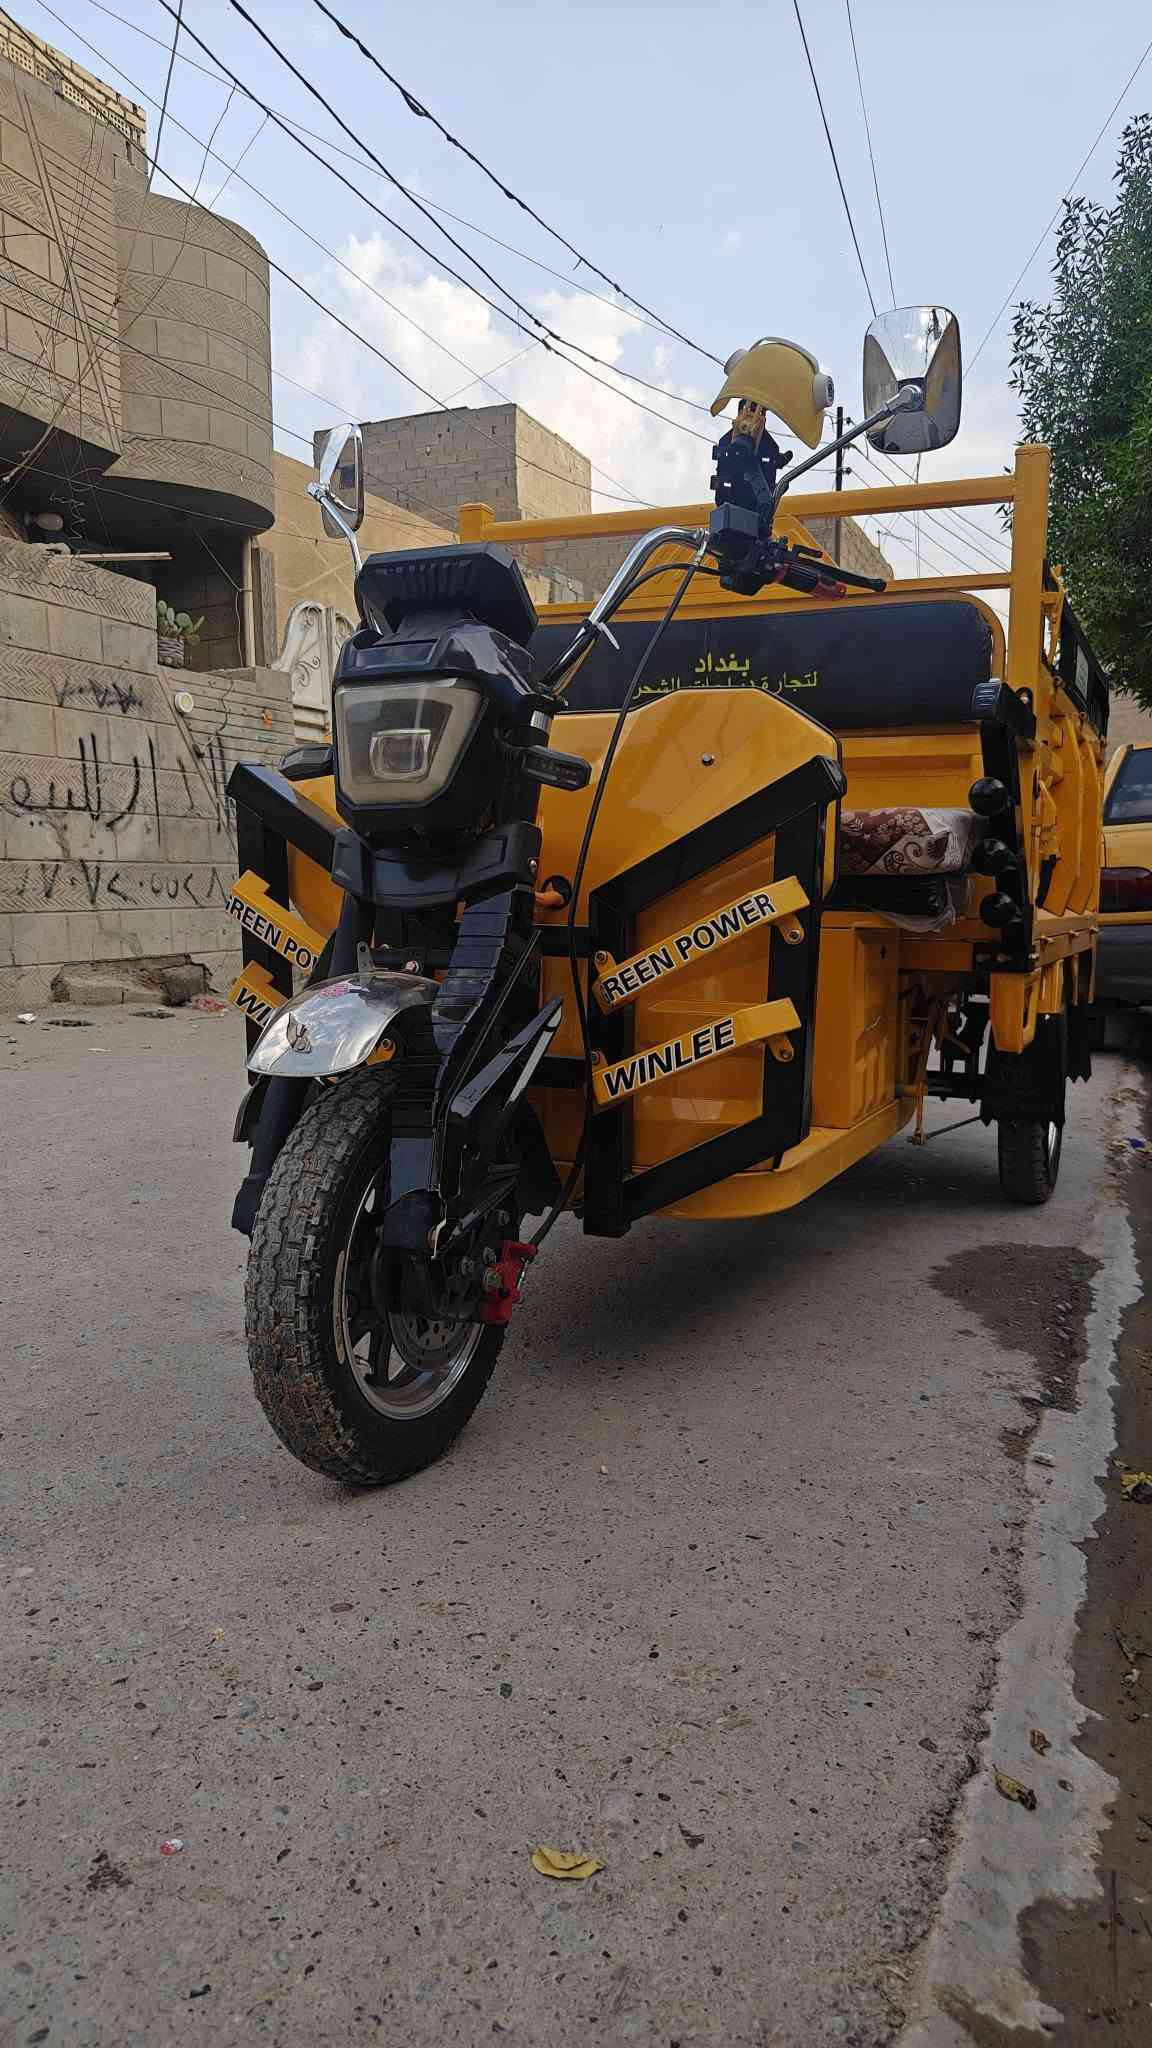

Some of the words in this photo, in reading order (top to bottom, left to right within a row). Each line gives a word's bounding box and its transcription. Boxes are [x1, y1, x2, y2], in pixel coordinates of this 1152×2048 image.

[694, 652, 751, 678] بغداد
[600, 948, 676, 1003] REEN
[674, 892, 777, 961] POWER
[603, 1017, 735, 1098] WINLEE
